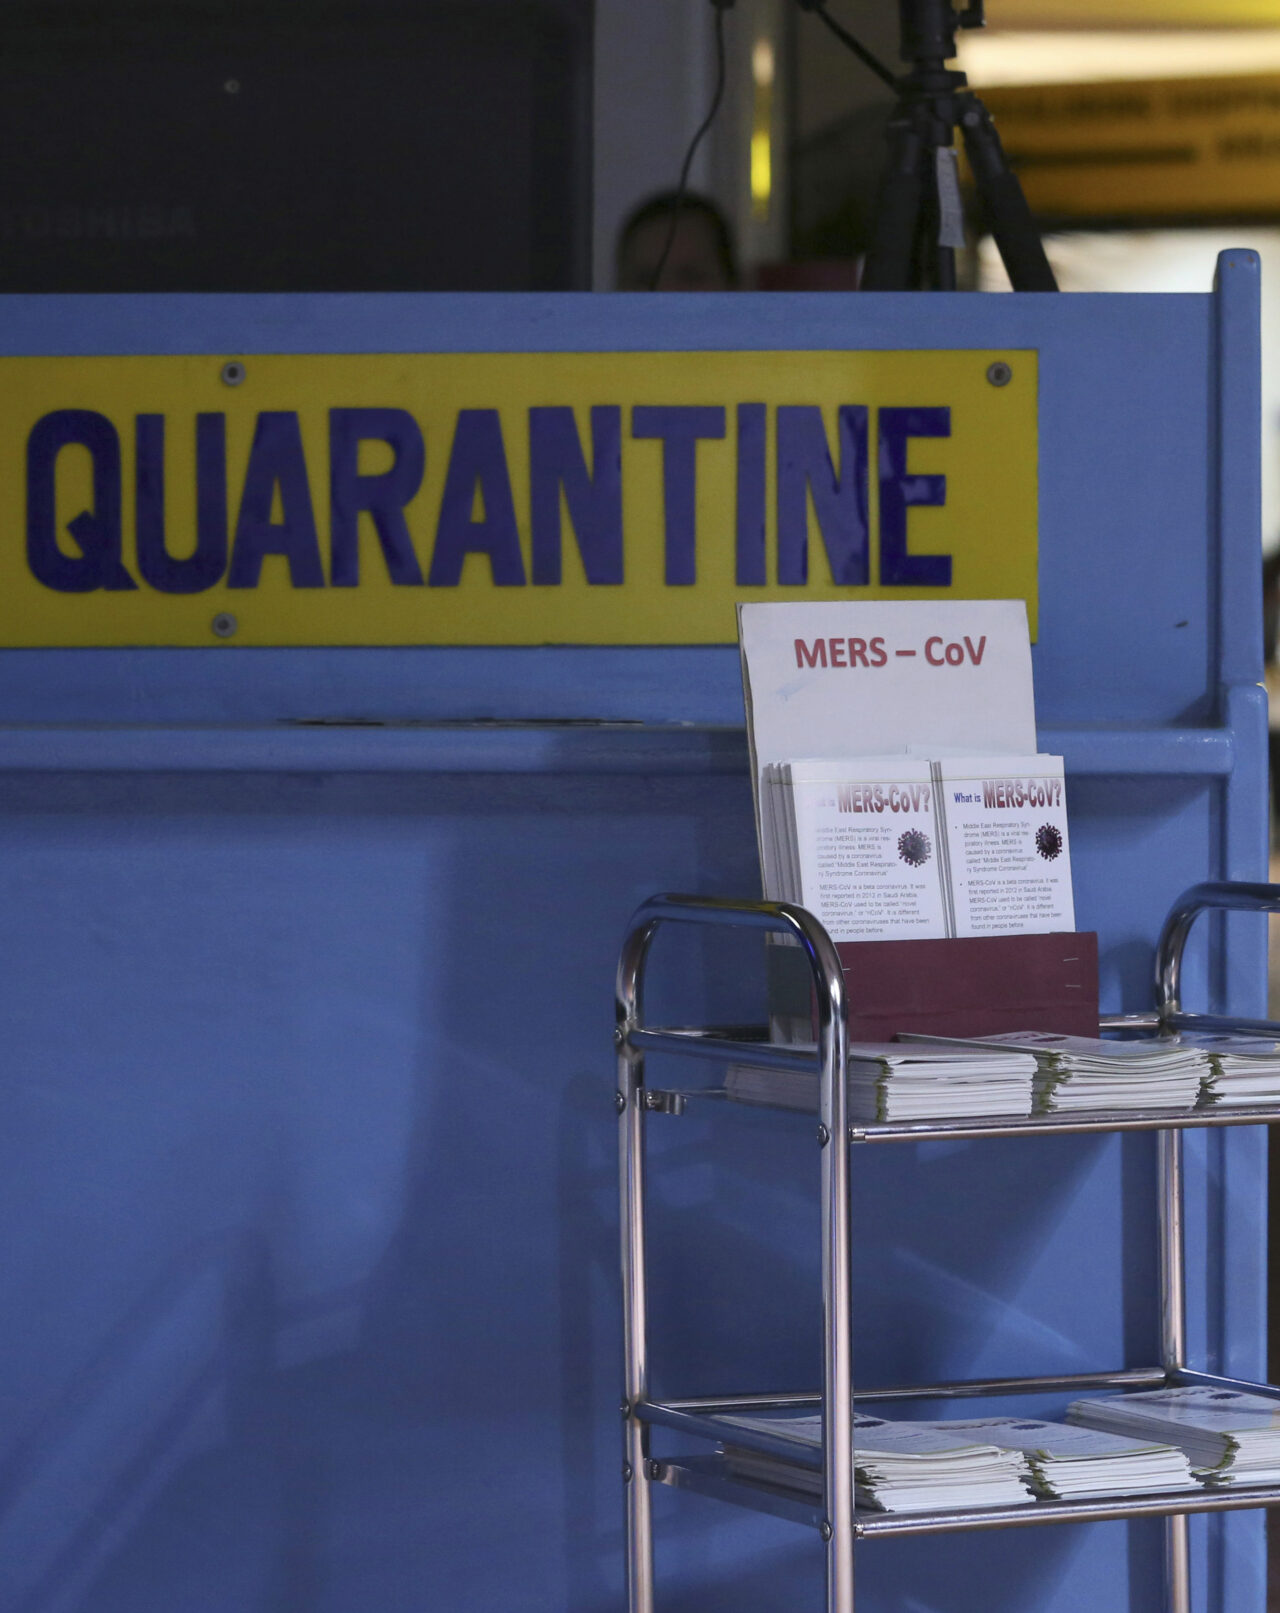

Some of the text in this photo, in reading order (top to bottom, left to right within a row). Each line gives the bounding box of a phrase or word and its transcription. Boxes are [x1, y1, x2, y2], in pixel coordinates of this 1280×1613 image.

[24, 402, 953, 594] QUARANTINE
[794, 637, 888, 668] MERS
[924, 635, 987, 666] CoV
[838, 785, 930, 813] MERS-CoV?
[954, 779, 1062, 808] What is MERS-CoV?
